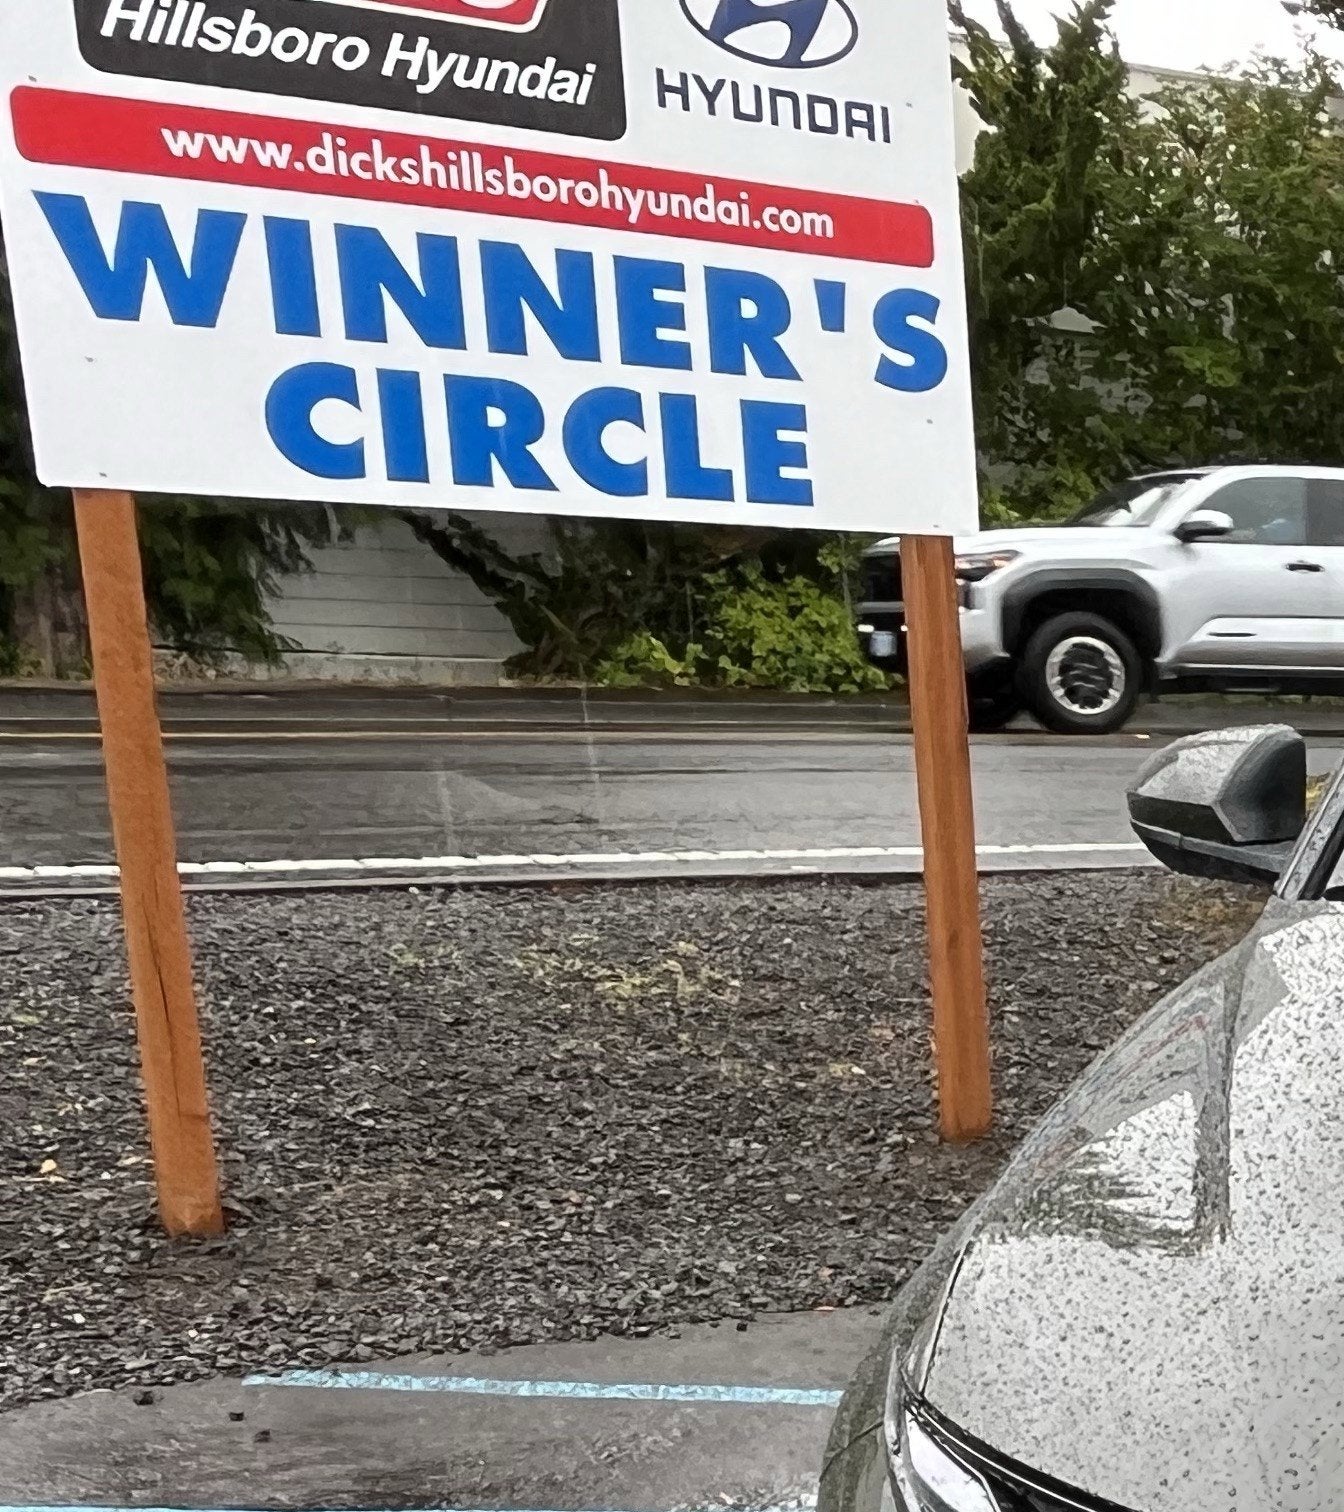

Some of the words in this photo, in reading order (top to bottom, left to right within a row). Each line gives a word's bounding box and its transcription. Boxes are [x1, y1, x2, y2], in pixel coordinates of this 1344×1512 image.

[101, 0, 370, 71] Hillsboro
[381, 32, 597, 105] Hyundai
[655, 68, 892, 144] HYUNDAI
[160, 125, 835, 240] www.dickshillsborohyundai.com
[31, 191, 948, 393] WINNER'S
[265, 362, 814, 508] CIRCLE
